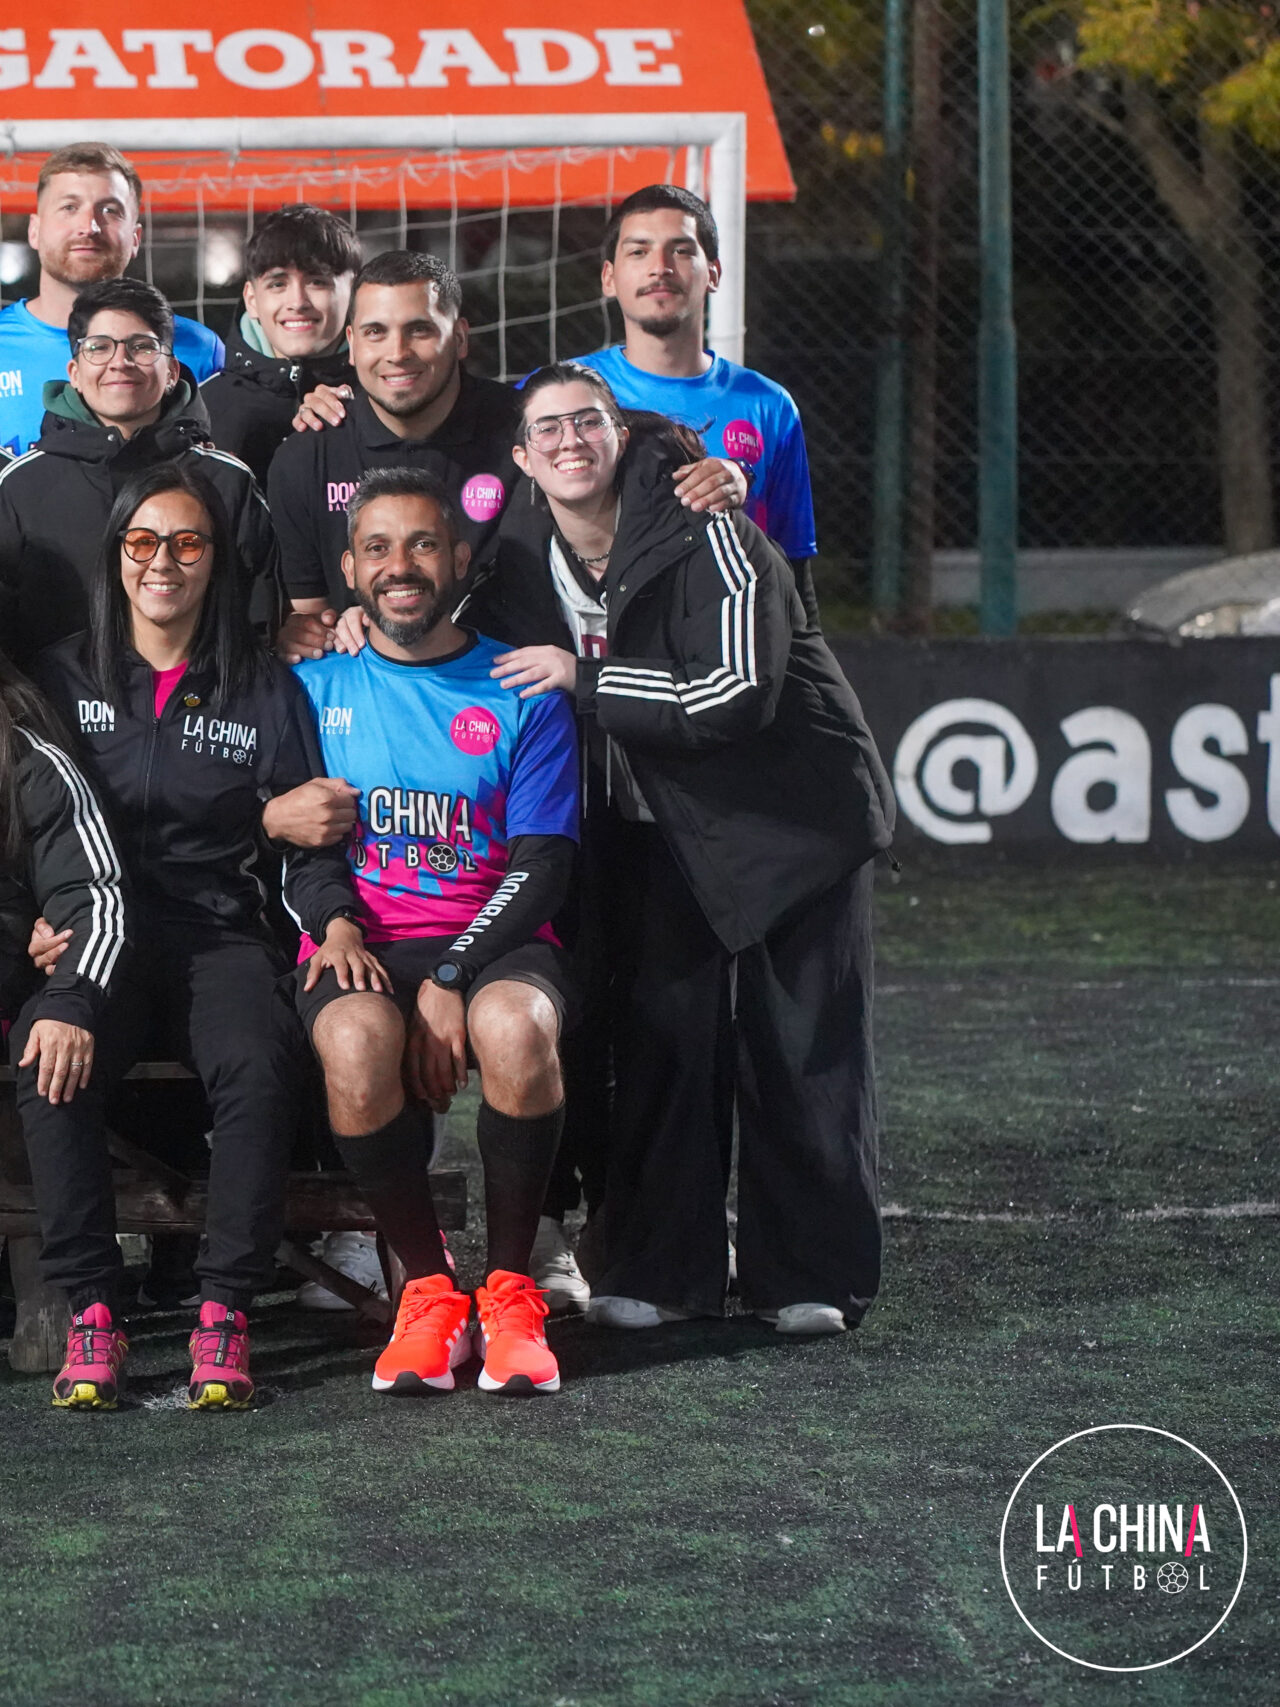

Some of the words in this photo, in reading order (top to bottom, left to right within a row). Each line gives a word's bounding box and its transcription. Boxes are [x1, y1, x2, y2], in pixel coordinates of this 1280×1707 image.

[466, 486, 476, 499] LA
[477, 487, 502, 499] CHINA
[329, 503, 348, 512] BAL
[78, 700, 115, 724] DON
[321, 706, 353, 727] DON
[81, 724, 115, 733] BALON
[183, 715, 204, 740] LA
[208, 719, 256, 750] CHINA
[455, 719, 467, 732] LA
[469, 720, 496, 734] CHINA
[369, 787, 472, 845] CHINA
[355, 838, 477, 874] ÚTBOL
